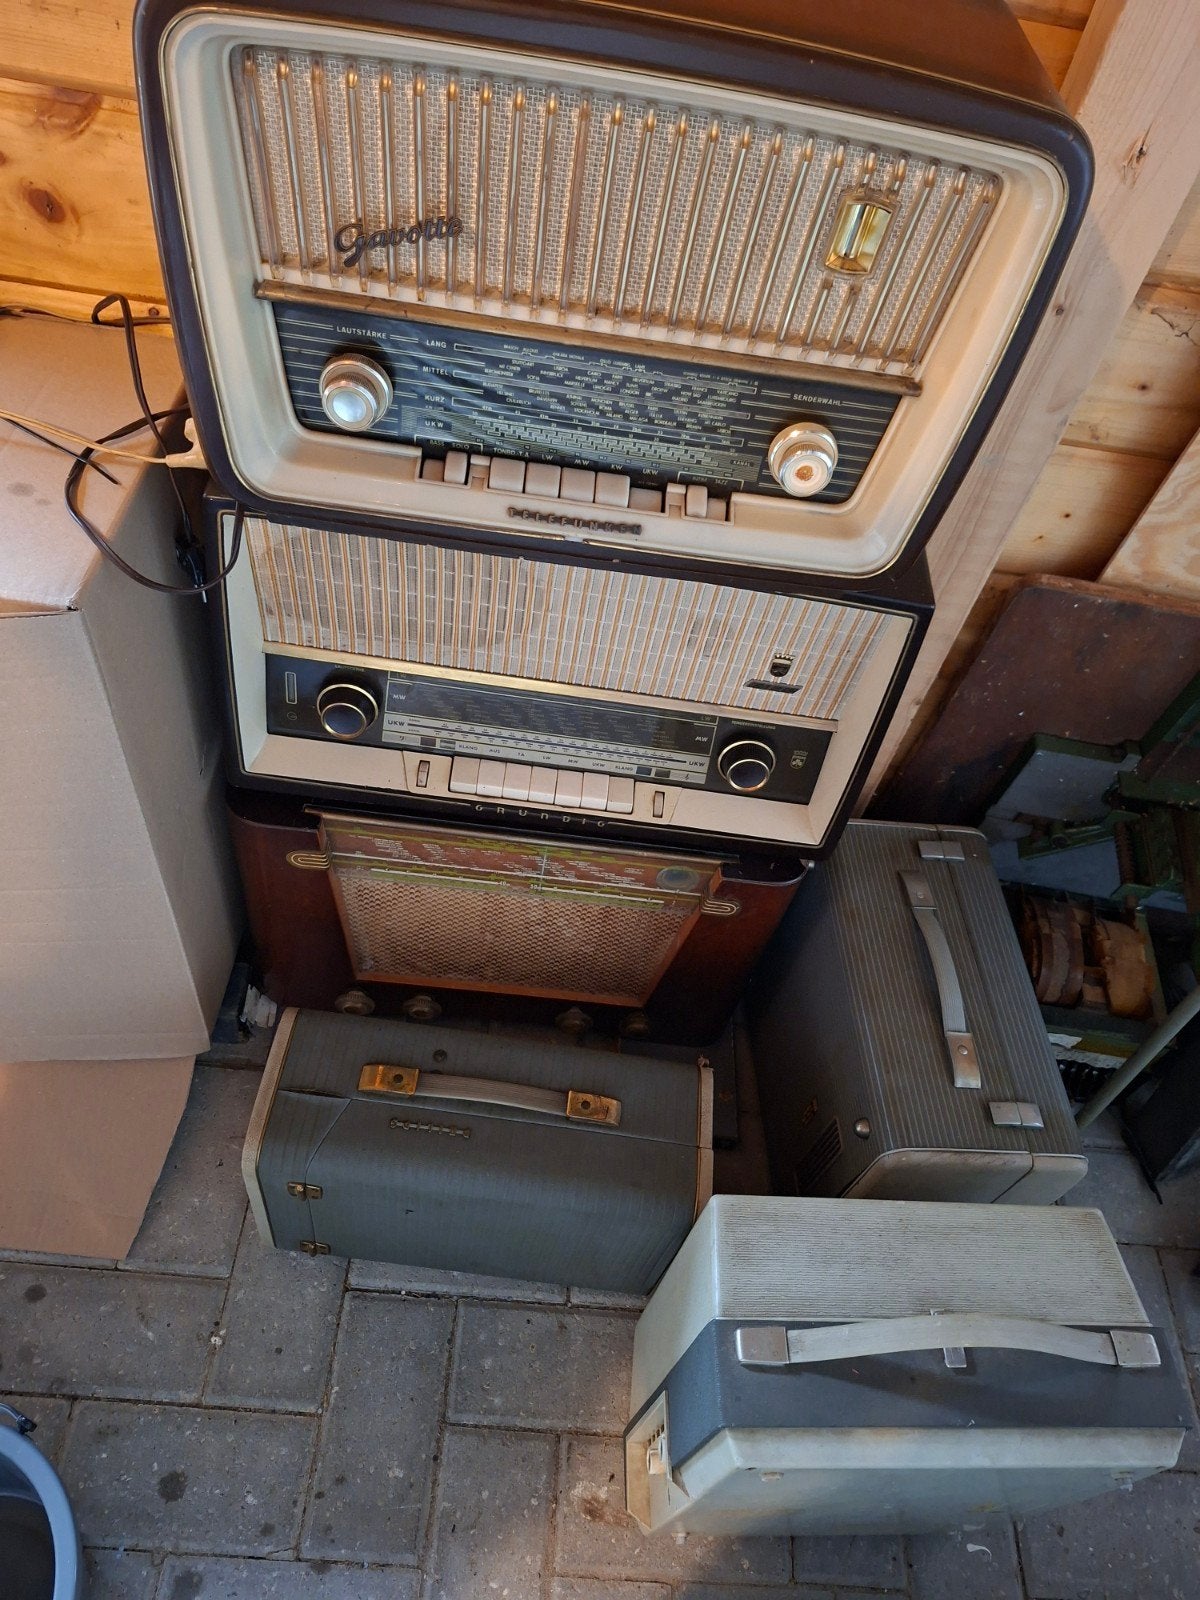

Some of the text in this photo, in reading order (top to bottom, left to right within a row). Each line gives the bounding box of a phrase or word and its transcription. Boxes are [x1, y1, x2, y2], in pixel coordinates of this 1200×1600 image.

[336, 326, 387, 340] LAUTSTÄRKE
[426, 339, 447, 348] LANG
[422, 365, 449, 376] MITTEL
[425, 394, 446, 402] KURZ
[793, 393, 842, 406] SENDERWAHL
[425, 420, 444, 429] UKW
[573, 458, 590, 466] MW
[642, 468, 659, 476] UKW
[507, 506, 643, 536] TELEFUNKEN
[387, 719, 405, 727] UKW
[475, 804, 605, 828] GRUNDIG
